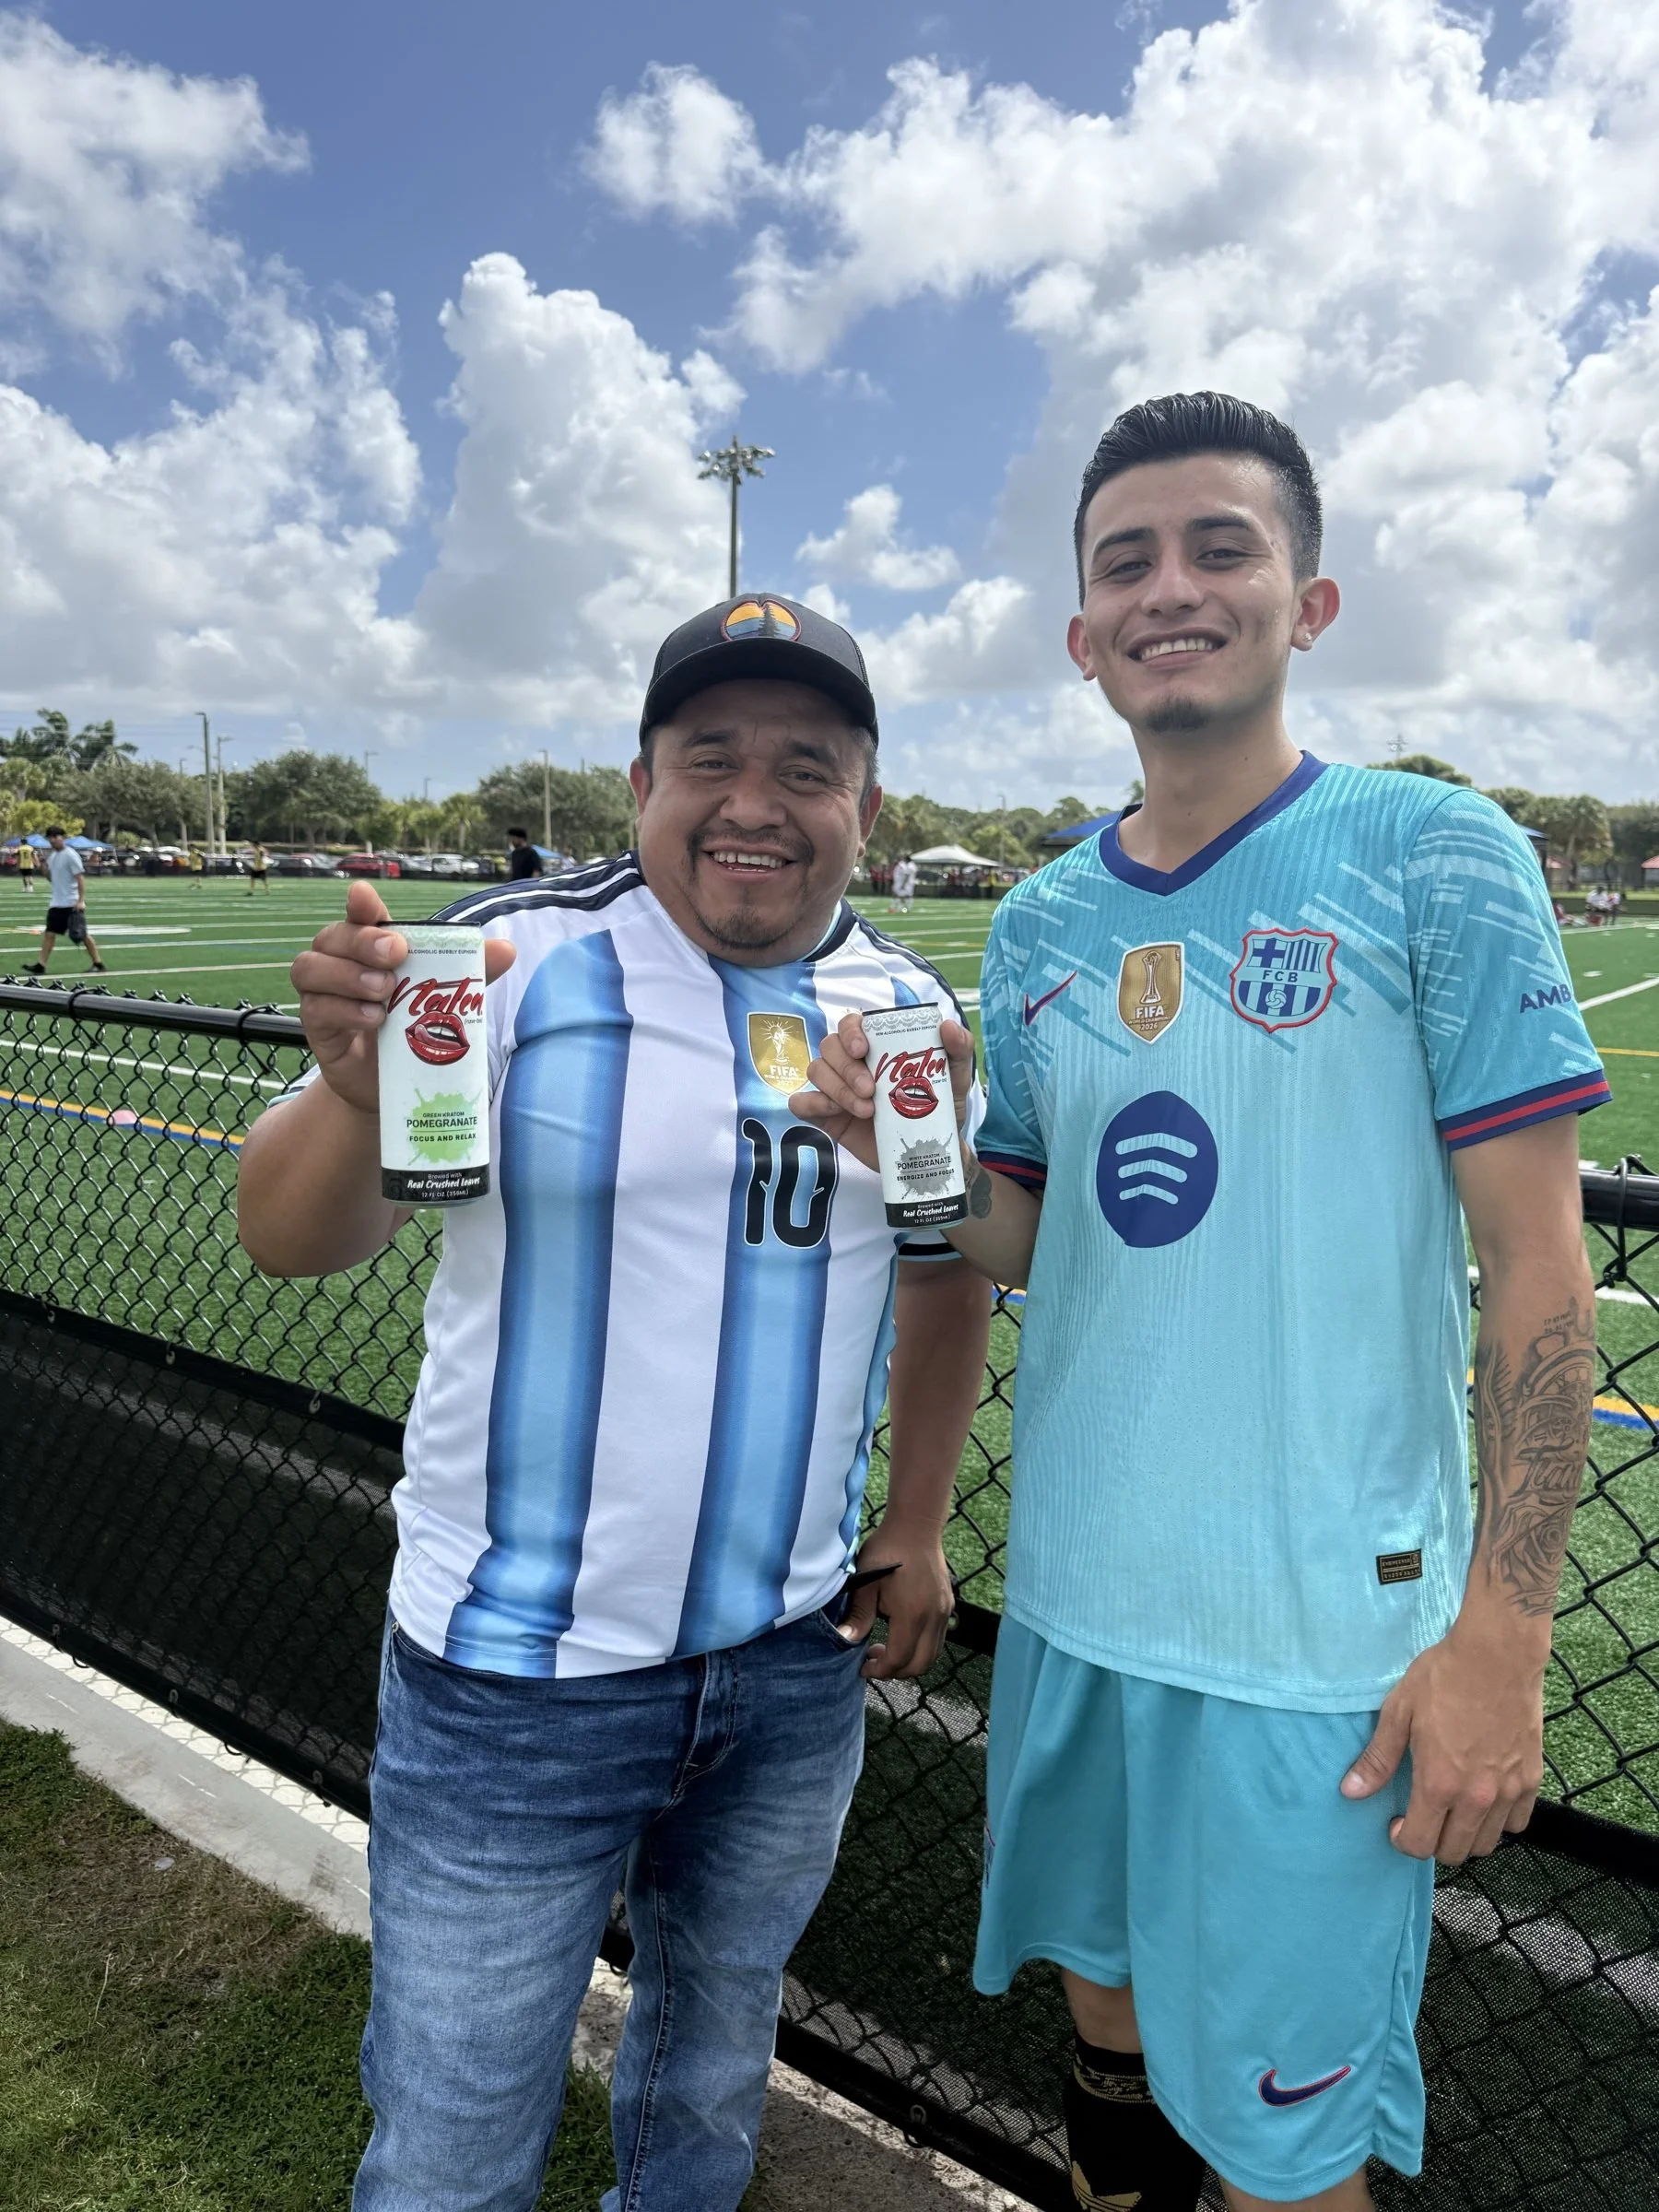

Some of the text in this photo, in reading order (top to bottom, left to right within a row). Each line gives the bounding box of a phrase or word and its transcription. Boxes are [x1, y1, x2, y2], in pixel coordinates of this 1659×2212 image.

[1262, 970, 1299, 983] FCB
[1135, 1005, 1165, 1019] FIFA
[770, 1065, 798, 1077] FIFA
[406, 1116, 478, 1128] POMEGRANATE
[455, 1133, 477, 1141] RELAX
[897, 1156, 952, 1171] POMEGRANATE
[897, 1173, 924, 1182] ENERGIZE
[938, 1168, 955, 1176] FOCUS
[407, 1176, 480, 1189] Real Crushed Leaves
[741, 1118, 838, 1248] 10
[902, 1204, 959, 1218] Real Crushed Leaves
